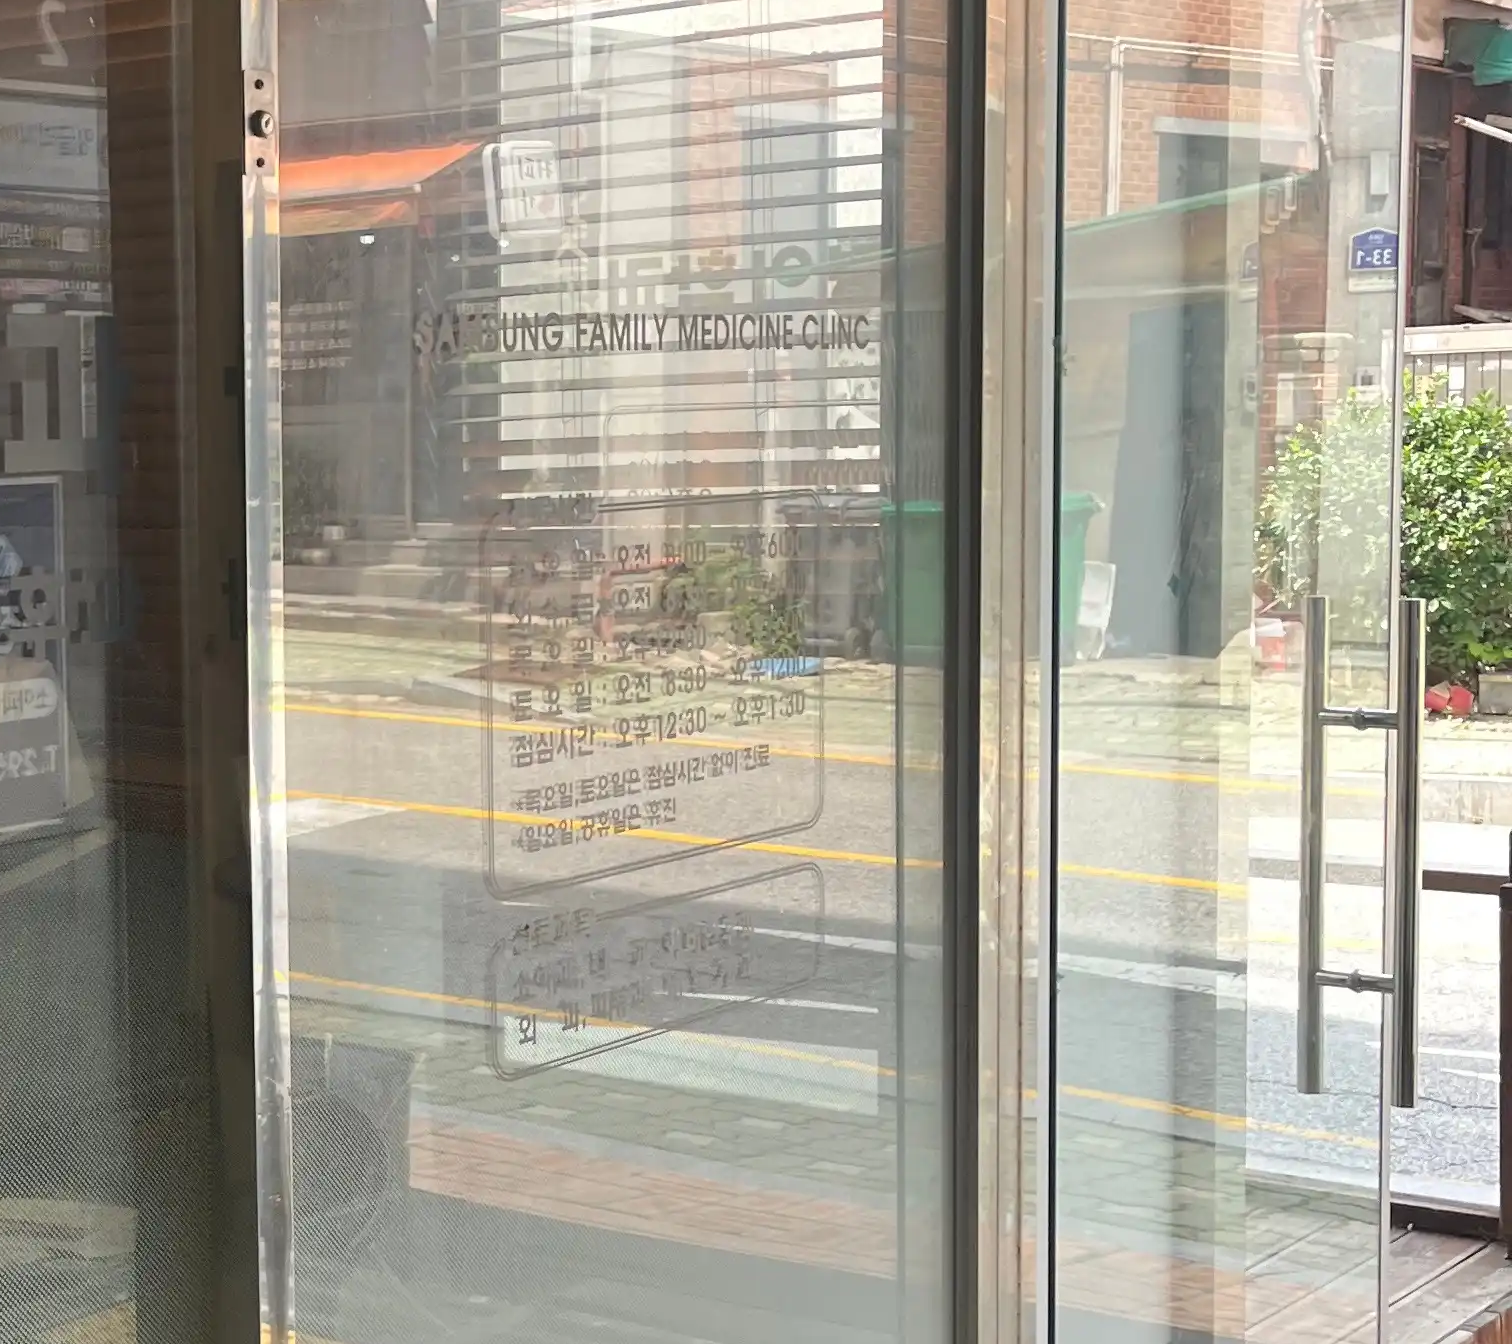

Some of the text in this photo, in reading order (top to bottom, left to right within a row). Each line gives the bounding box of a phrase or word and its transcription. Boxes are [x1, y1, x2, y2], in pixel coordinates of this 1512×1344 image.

[574, 311, 671, 354] FAMILY
[677, 311, 794, 352] MEDICINE
[508, 723, 595, 769] 점심시간
